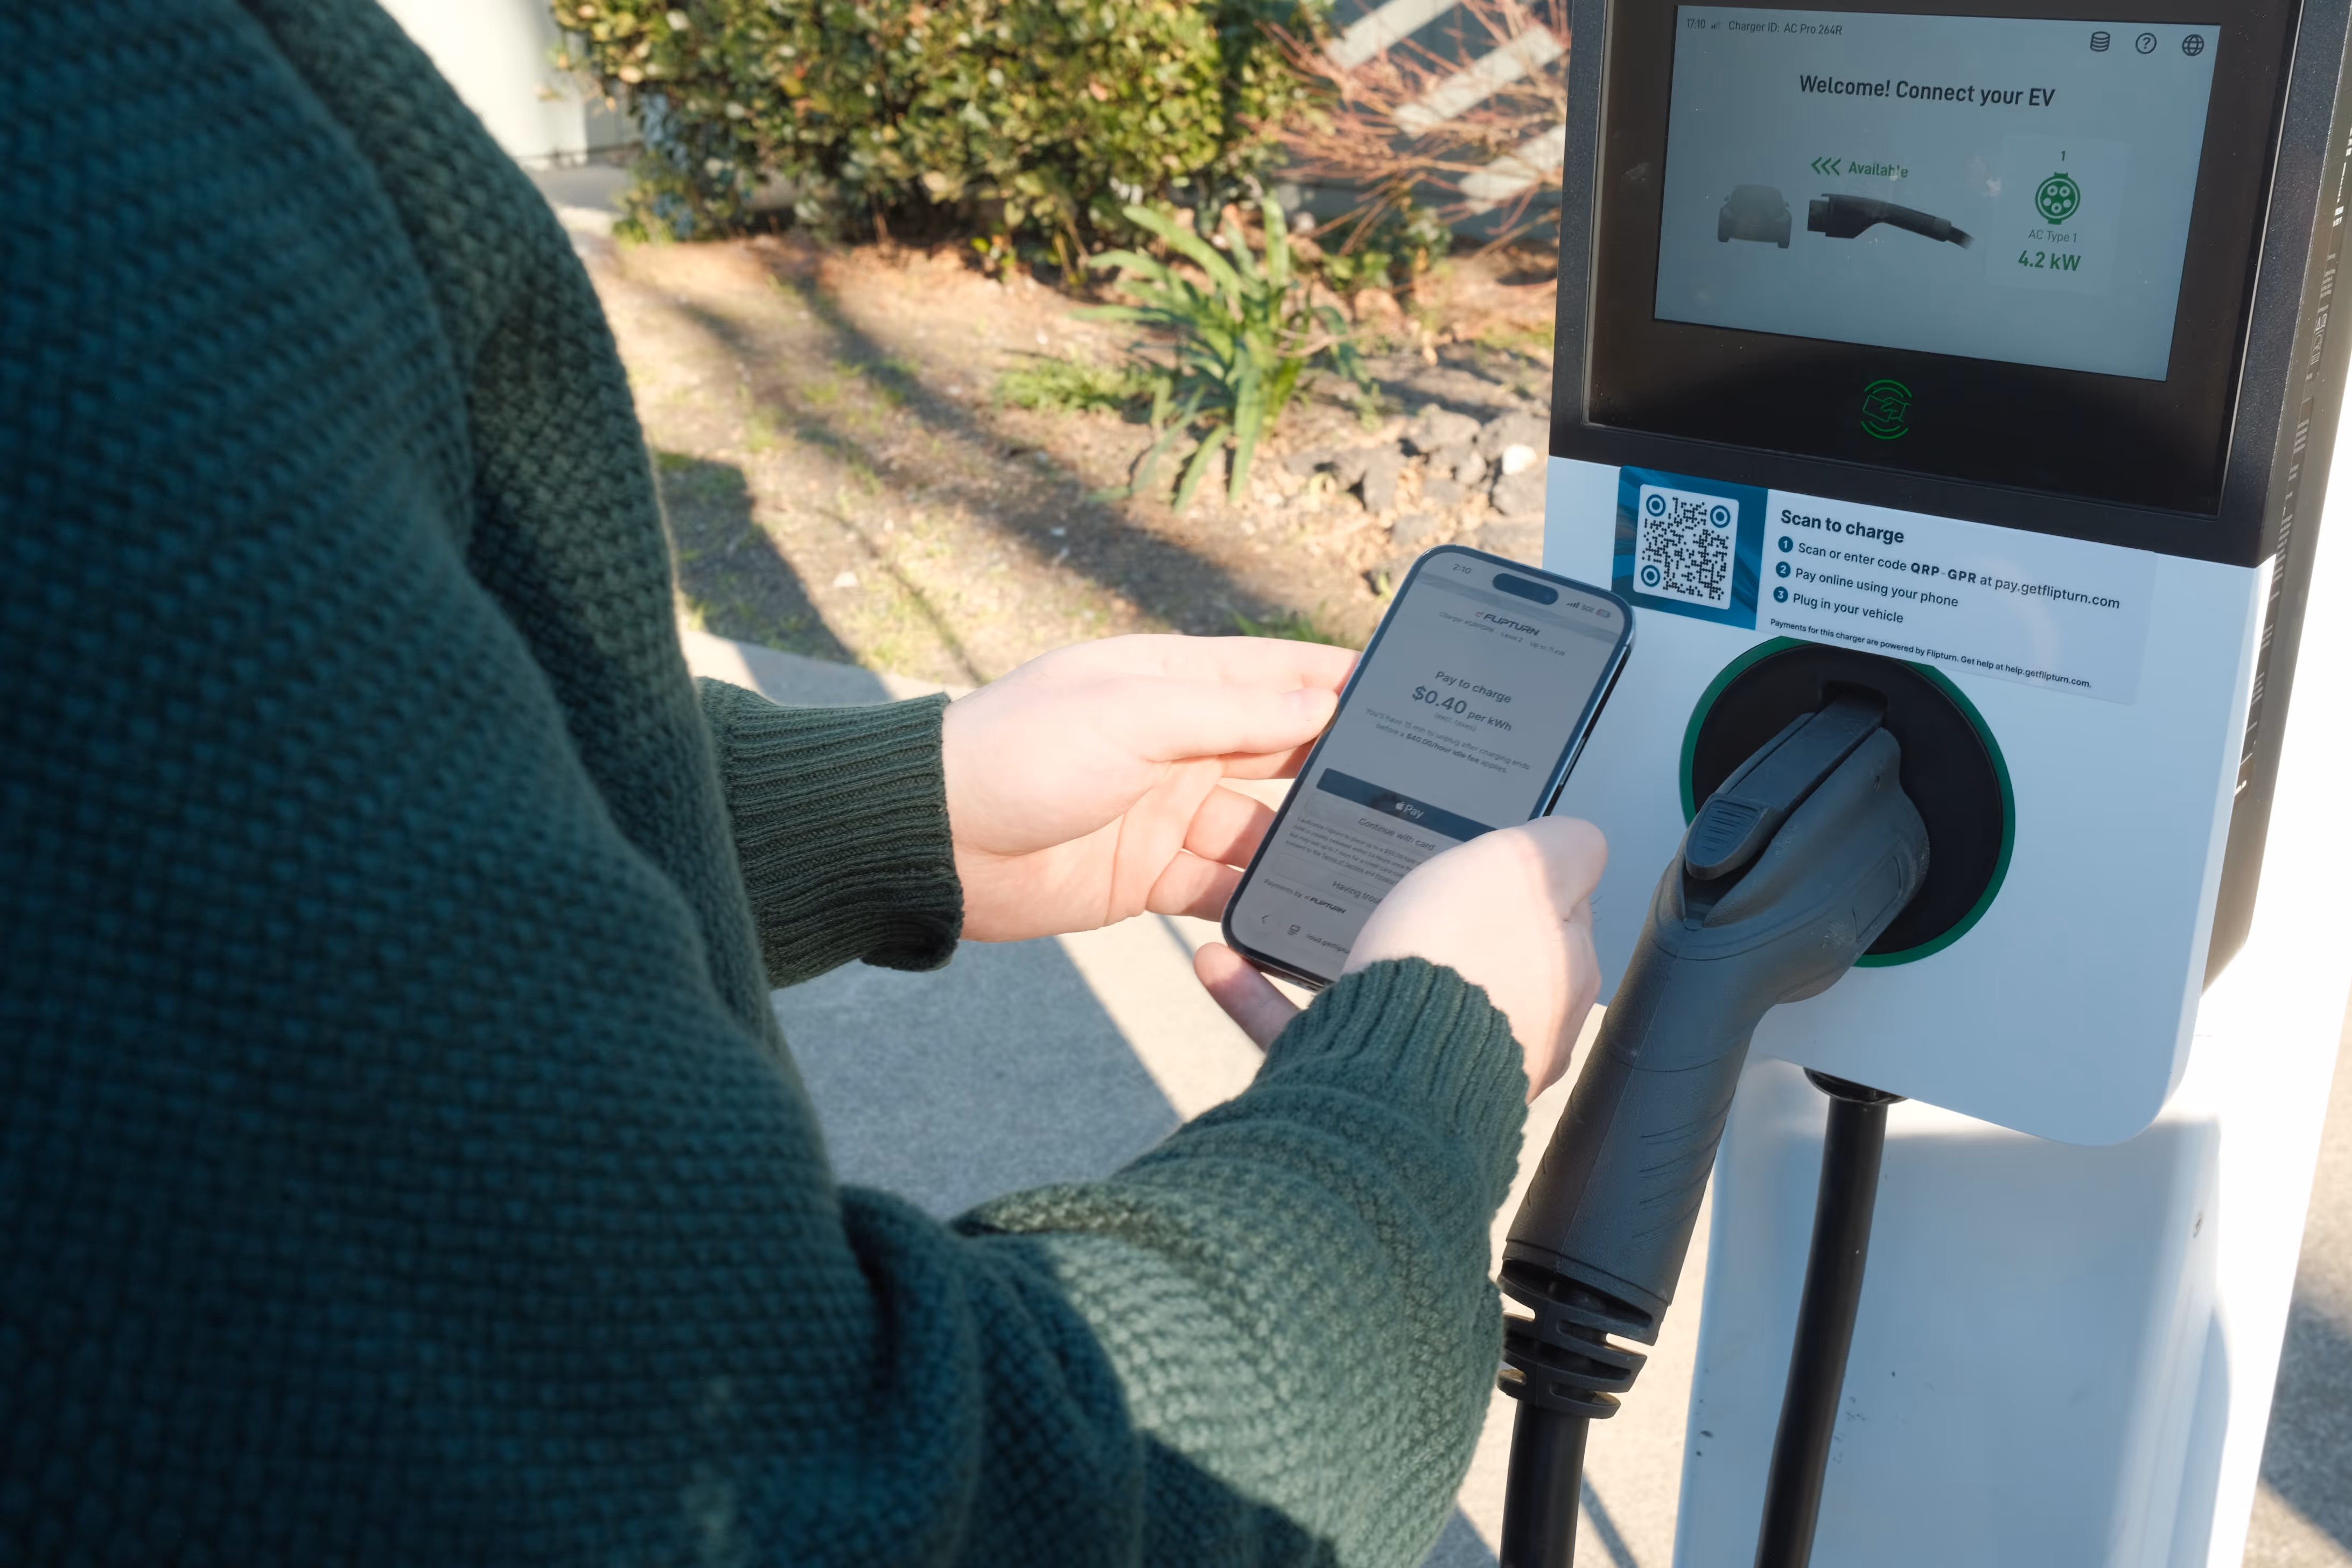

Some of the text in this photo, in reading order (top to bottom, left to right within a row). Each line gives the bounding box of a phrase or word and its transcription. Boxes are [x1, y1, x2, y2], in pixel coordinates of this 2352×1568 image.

[1687, 19, 1706, 29] 17:10
[1728, 20, 1843, 35] Charger ID: AC Pro 264R
[1800, 75, 2055, 106] Welcome! Connect your EV
[2061, 150, 2067, 162] 1
[2028, 229, 2077, 243] AC Type 1
[2018, 250, 2081, 271] 4.2 kW
[1781, 509, 1903, 544] Scan to charge
[1452, 564, 1471, 573] 2:10
[1783, 540, 1787, 548] 1
[1798, 542, 1825, 556] Scan
[1829, 550, 1841, 559] or
[1844, 553, 1874, 564] enter
[1878, 559, 1906, 571] code
[1980, 576, 1992, 586] at
[1994, 579, 2119, 608] pay.getflipturn.com
[1780, 565, 1958, 606] 2 Pay online using your phone
[1777, 590, 1903, 622] 3 Plug in your vehicle
[1483, 613, 1540, 635] FLIPTURN
[1770, 618, 1806, 632] Payments
[1820, 628, 1834, 637] this
[1836, 632, 1865, 643] charger
[1880, 641, 1914, 652] powered
[1915, 647, 1924, 656] by
[1927, 649, 1958, 661] Flipturn.
[1961, 656, 1975, 664] Get
[1976, 659, 1993, 669] help
[2005, 664, 2091, 687] help.getflipturn.com.
[1435, 671, 1511, 703] Pay to charge
[1412, 685, 1511, 731] $0.40 per kWh
[1403, 804, 1424, 818] Pay
[1359, 818, 1395, 836] Continue
[1397, 832, 1413, 843] with
[1416, 839, 1434, 850] card
[1333, 881, 1361, 897] Having
